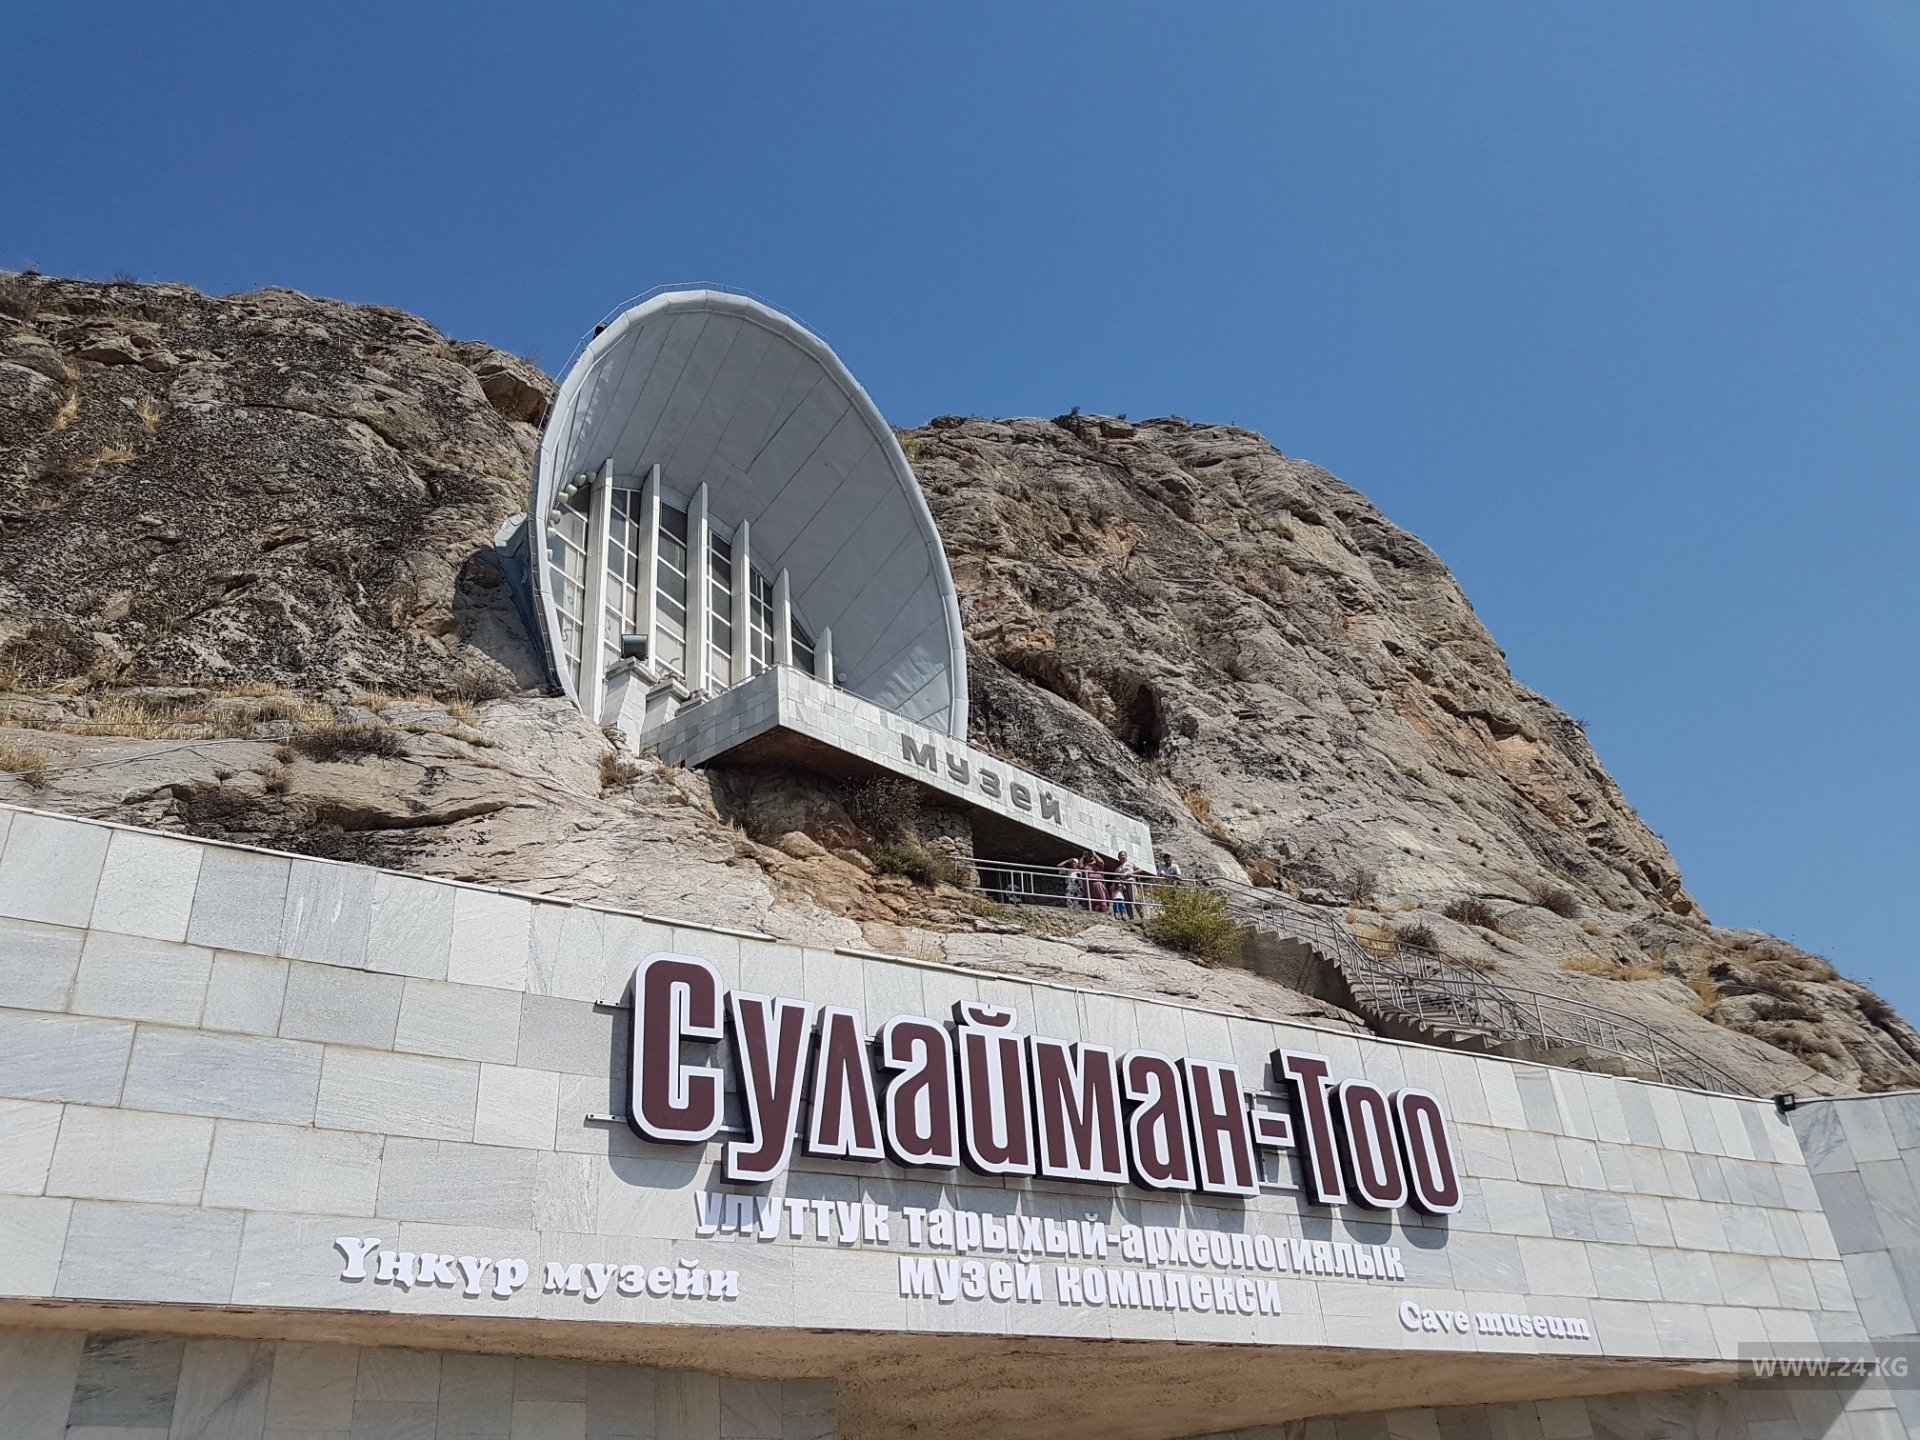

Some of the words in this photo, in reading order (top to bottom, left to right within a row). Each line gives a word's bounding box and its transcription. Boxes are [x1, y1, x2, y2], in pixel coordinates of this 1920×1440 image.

[628, 952, 1464, 1215] Сулайман-Тоо
[334, 1236, 530, 1299] Үңкүр
[542, 1258, 739, 1303] музейи
[899, 1253, 1043, 1304] музей
[1056, 1266, 1281, 1315] комплекси
[1399, 1300, 1470, 1334] Cave
[1475, 1311, 1590, 1340] museum
